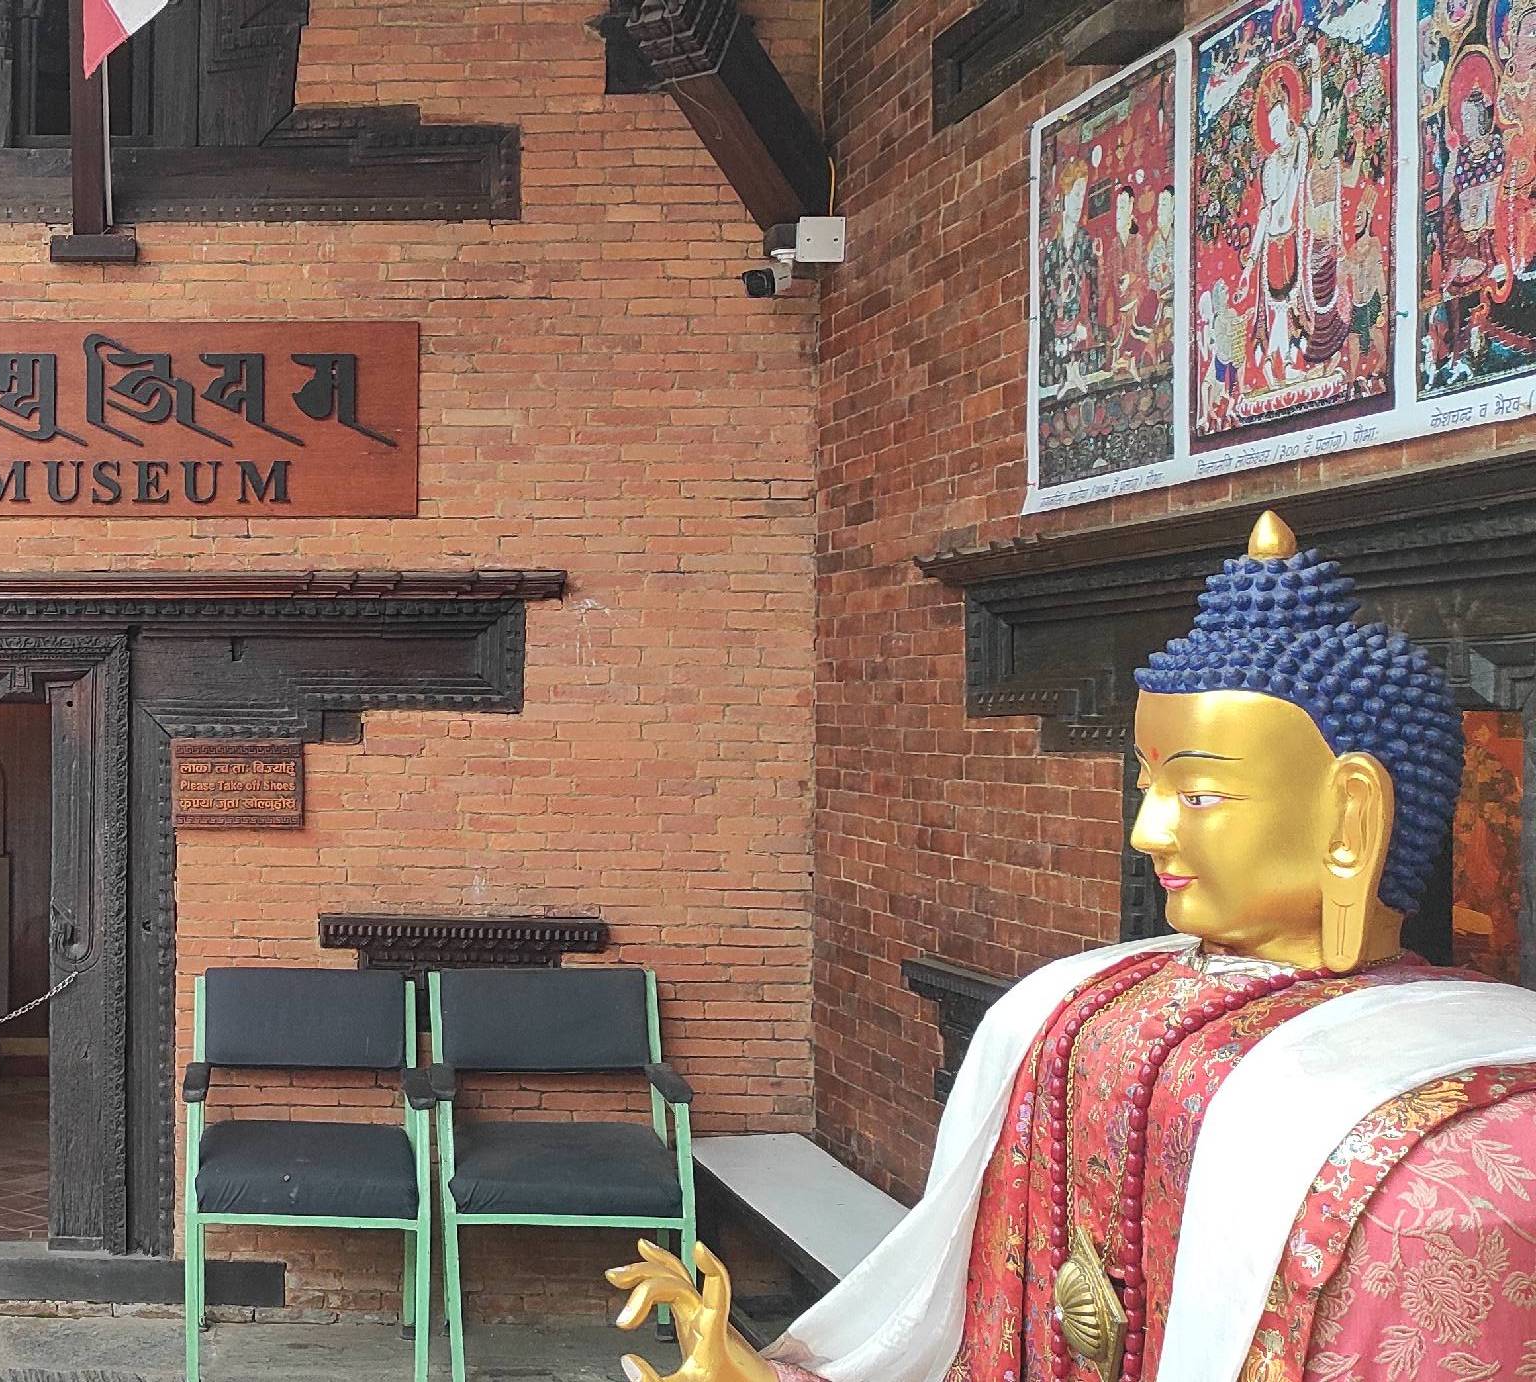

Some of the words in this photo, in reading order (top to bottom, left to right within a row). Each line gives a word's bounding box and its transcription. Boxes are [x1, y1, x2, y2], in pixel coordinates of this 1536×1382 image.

[180, 780, 215, 791] Please
[217, 780, 243, 791] Take
[245, 780, 261, 791] off
[263, 780, 296, 791] Shoes
